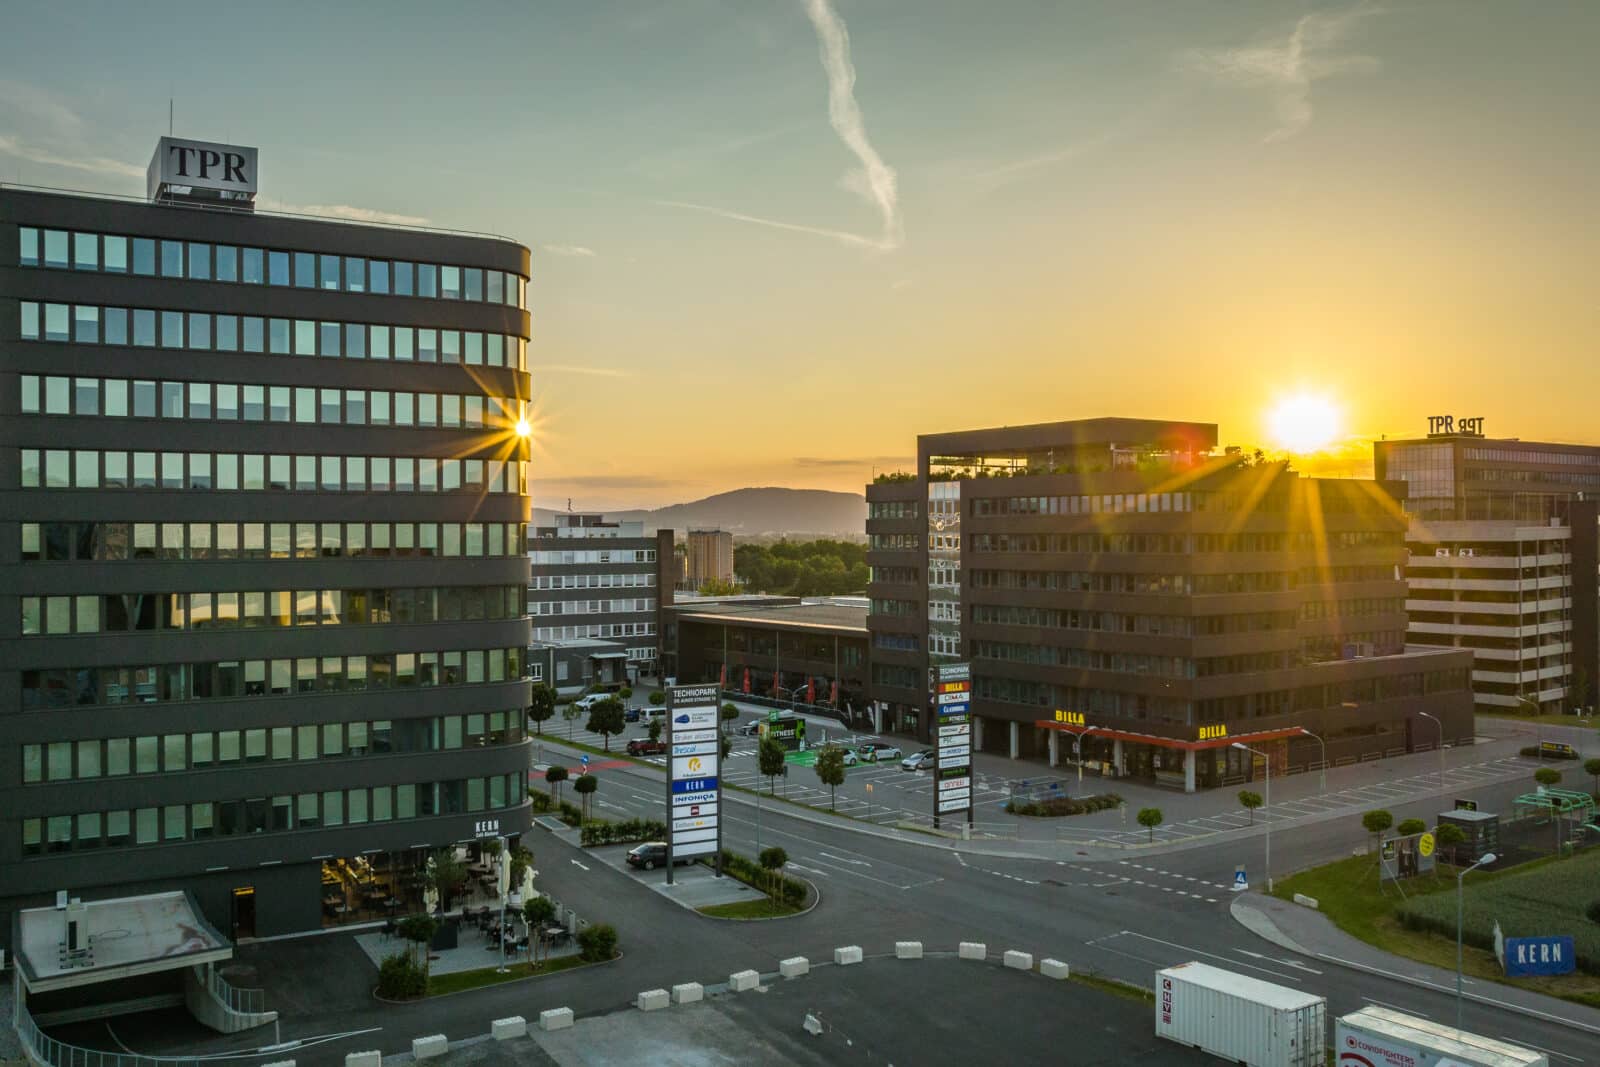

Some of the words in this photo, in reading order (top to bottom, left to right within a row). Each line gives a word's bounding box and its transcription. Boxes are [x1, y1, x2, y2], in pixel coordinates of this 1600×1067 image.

[169, 146, 248, 183] TPR
[1427, 415, 1454, 433] TPR
[672, 688, 717, 698] TECHNOPARK
[944, 682, 963, 692] BILLA
[1055, 709, 1085, 725] BILLA
[1199, 724, 1227, 740] BILLA
[675, 793, 715, 802] INFONIQA
[475, 819, 499, 832] KERN
[1518, 943, 1561, 964] KERN
[1358, 1041, 1415, 1065] COVIDFIGHTERS
